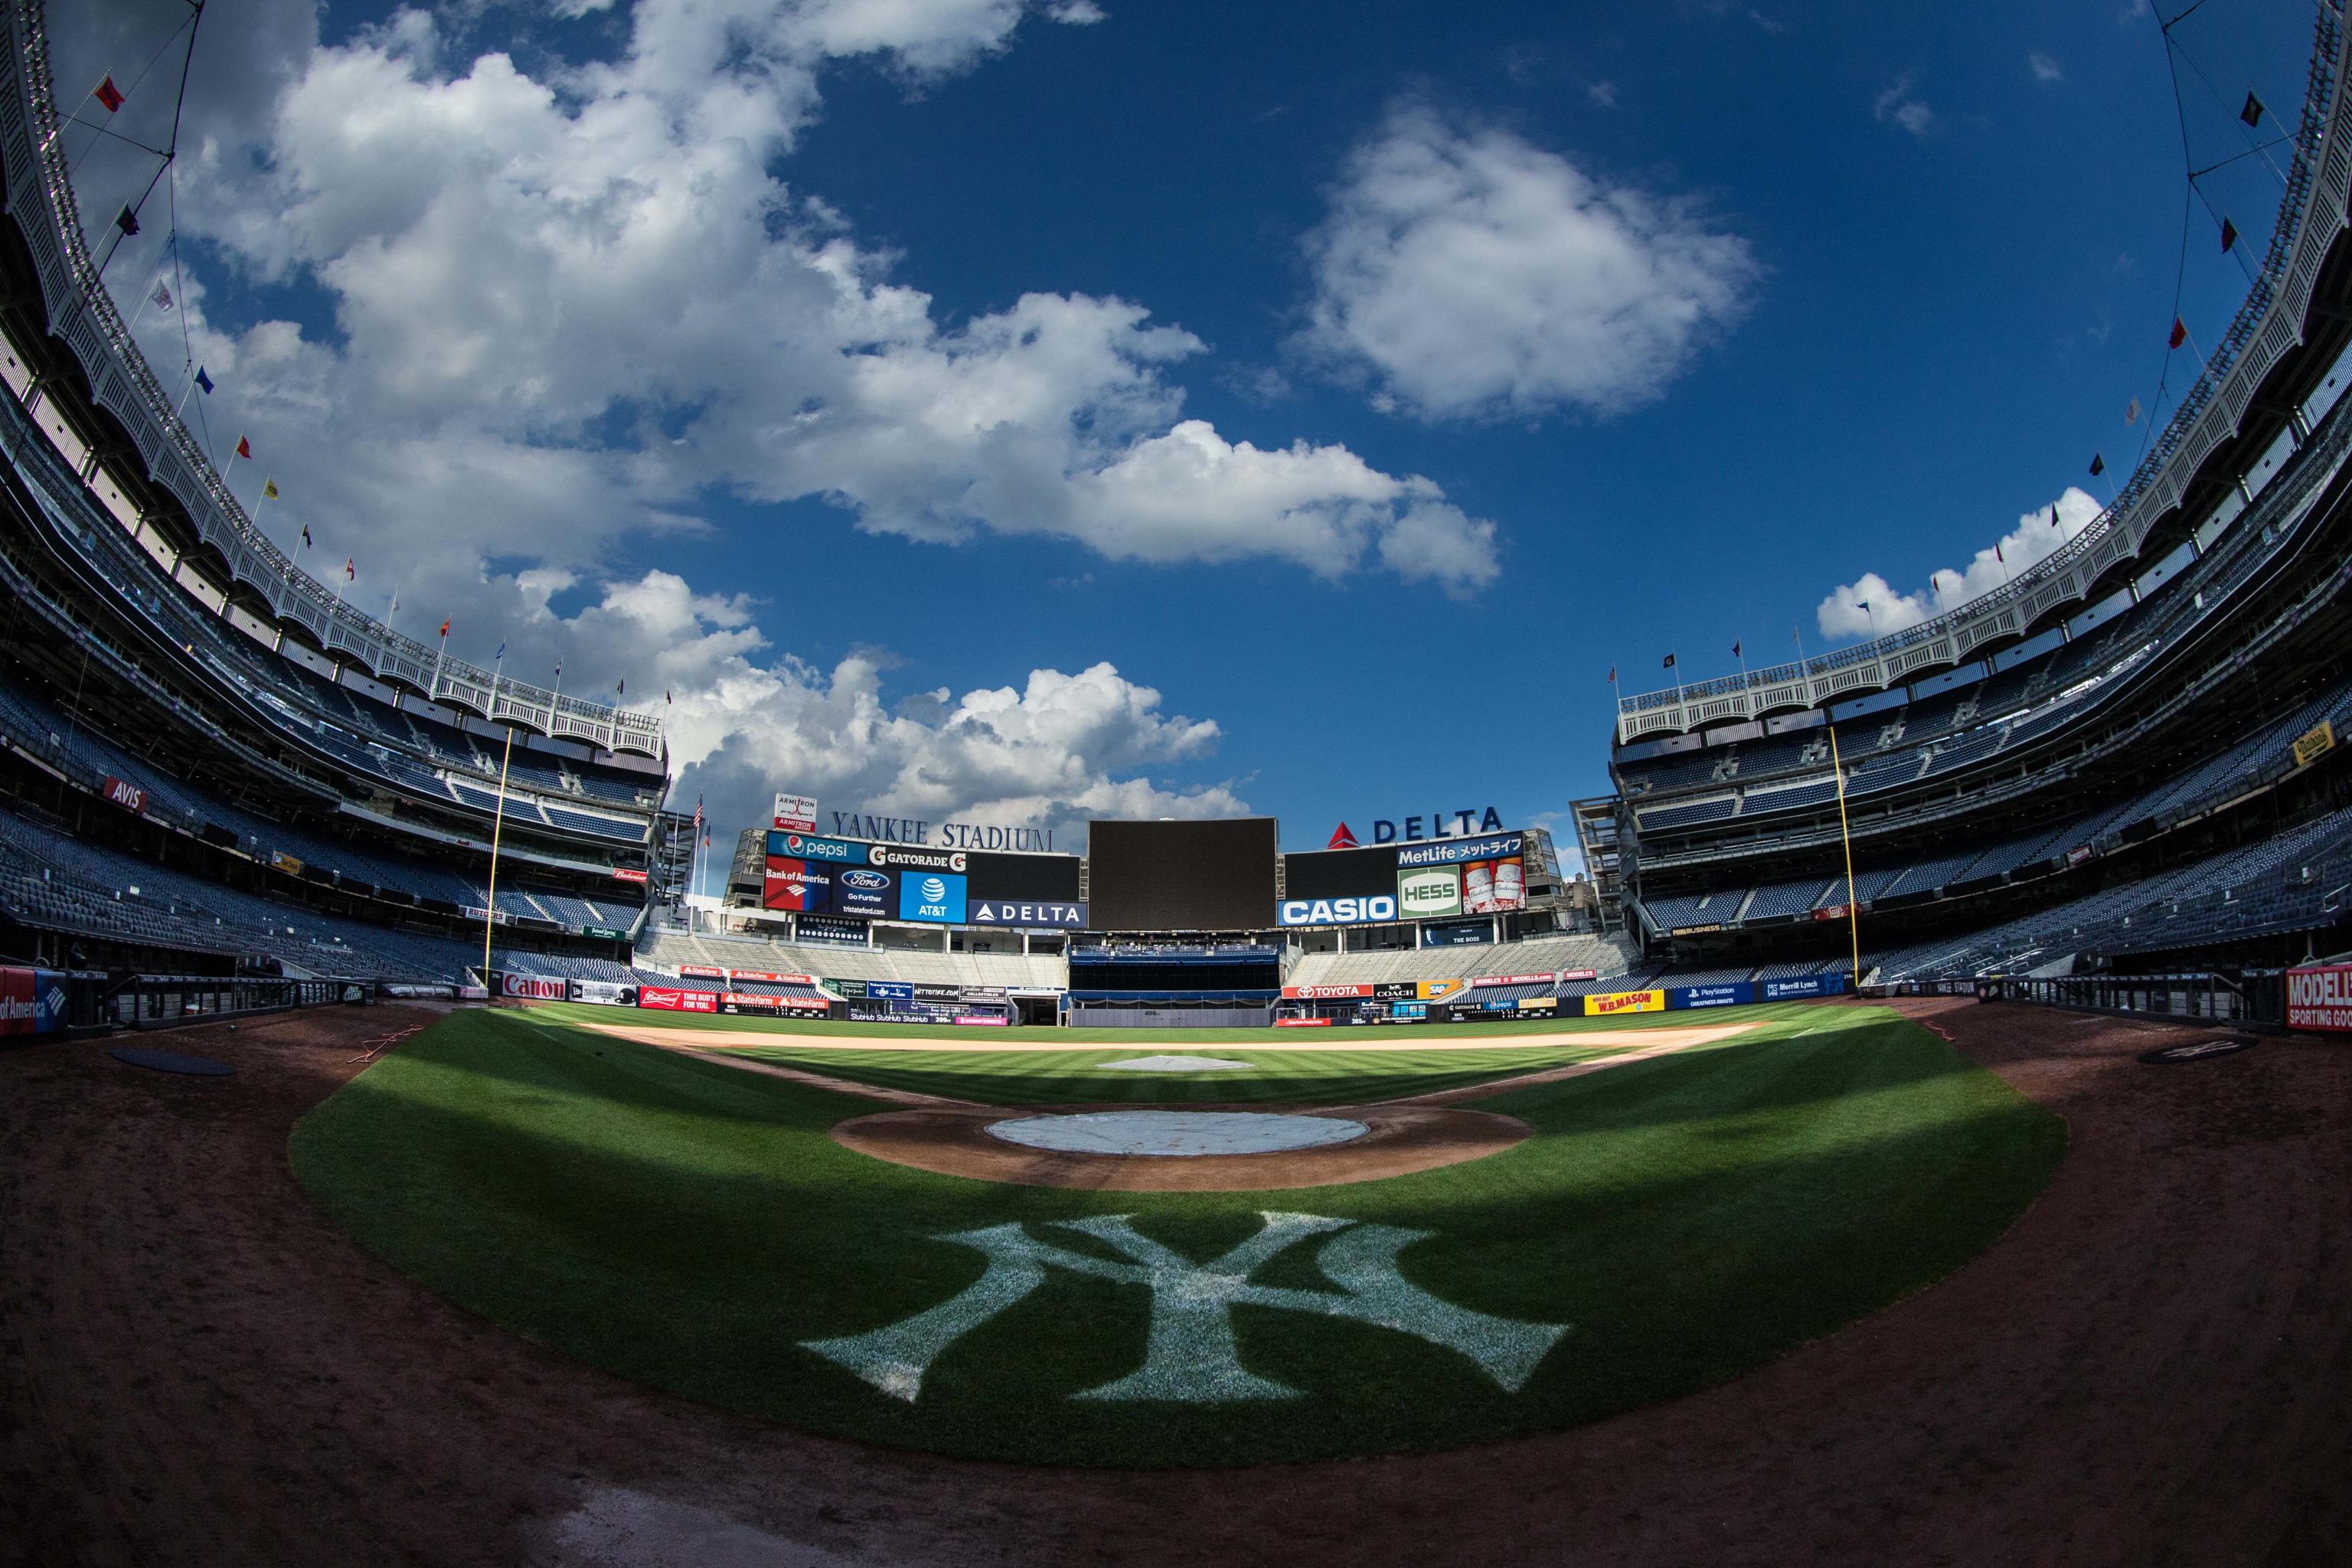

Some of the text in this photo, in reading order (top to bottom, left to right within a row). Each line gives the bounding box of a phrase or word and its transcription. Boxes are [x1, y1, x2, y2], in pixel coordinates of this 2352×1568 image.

[112, 782, 141, 808] AVIS
[779, 797, 815, 808] ARMITRON
[779, 819, 812, 828] ARMITRON
[831, 811, 1054, 852] YANKEE STADIUM
[1374, 806, 1504, 844] DELTA
[807, 843, 847, 858] pepsi
[1399, 845, 1455, 864] MetLife
[1460, 838, 1522, 858] メットライフ
[870, 846, 966, 872] G GATORADE G
[616, 871, 647, 880] Budweiser
[766, 868, 829, 885] Bank of America
[851, 872, 880, 888] Ford
[1405, 884, 1454, 901] HESS
[469, 909, 504, 920] RUTGRS
[843, 906, 885, 916] tristateford.com
[919, 905, 947, 916] AT&T
[1002, 905, 1080, 923] DELTA
[1283, 897, 1394, 924] CASIO
[1686, 925, 1720, 933] BUSINESS
[505, 974, 564, 998] Canon
[914, 988, 959, 997] NITTOTIRE.COM
[1315, 986, 1359, 996] TOYOTA
[1430, 985, 1445, 994] SAP
[1701, 988, 1734, 996] PlayStation
[1780, 980, 1818, 991] Merrill Lynch
[645, 993, 677, 1002] Budweiser
[0, 995, 45, 1020] of America
[2290, 1009, 2331, 1025] SPORTING
[797, 1210, 1573, 1403] NY
